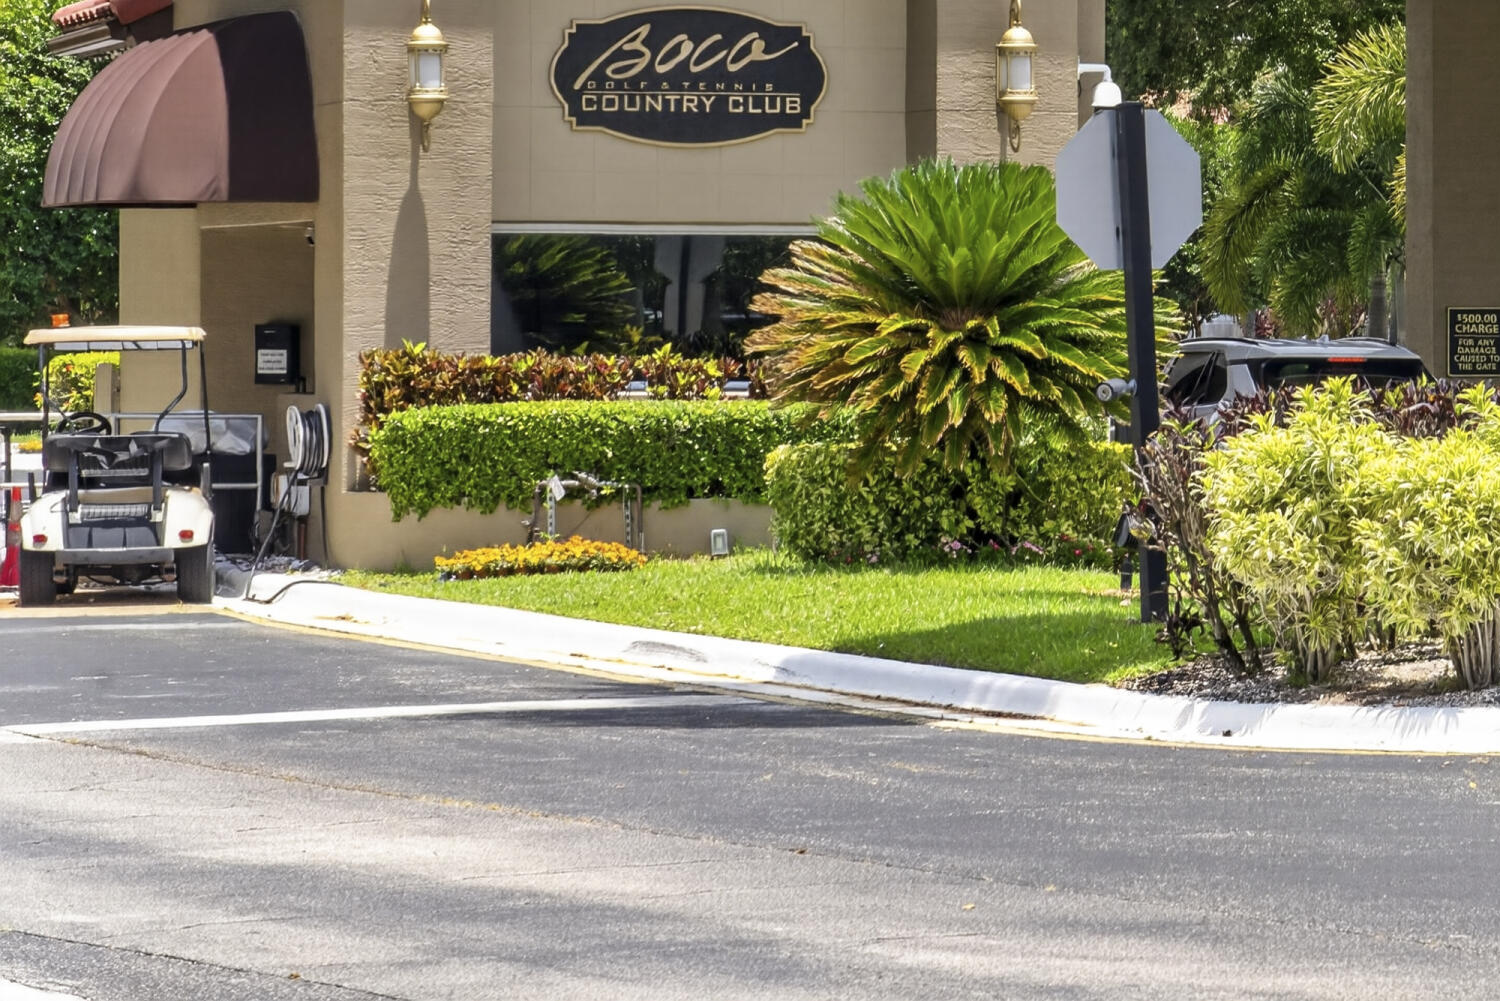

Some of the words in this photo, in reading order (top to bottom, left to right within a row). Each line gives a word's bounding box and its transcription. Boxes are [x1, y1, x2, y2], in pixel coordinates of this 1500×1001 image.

[573, 23, 799, 90] Boca
[587, 81, 647, 89] GOLF
[661, 81, 670, 90] &
[681, 81, 774, 92] TENNIS
[581, 94, 717, 113] COUNTRY
[728, 96, 801, 114] CLUB
[1455, 324, 1499, 333] CHARGE
[1458, 338, 1475, 346] FOR
[1477, 338, 1496, 346] ANY
[1457, 346, 1497, 354] DAMAGE
[1454, 354, 1487, 363] CAUSED
[1490, 354, 1500, 363] TO
[1458, 362, 1473, 371] THE
[1475, 362, 1497, 371] GATE
